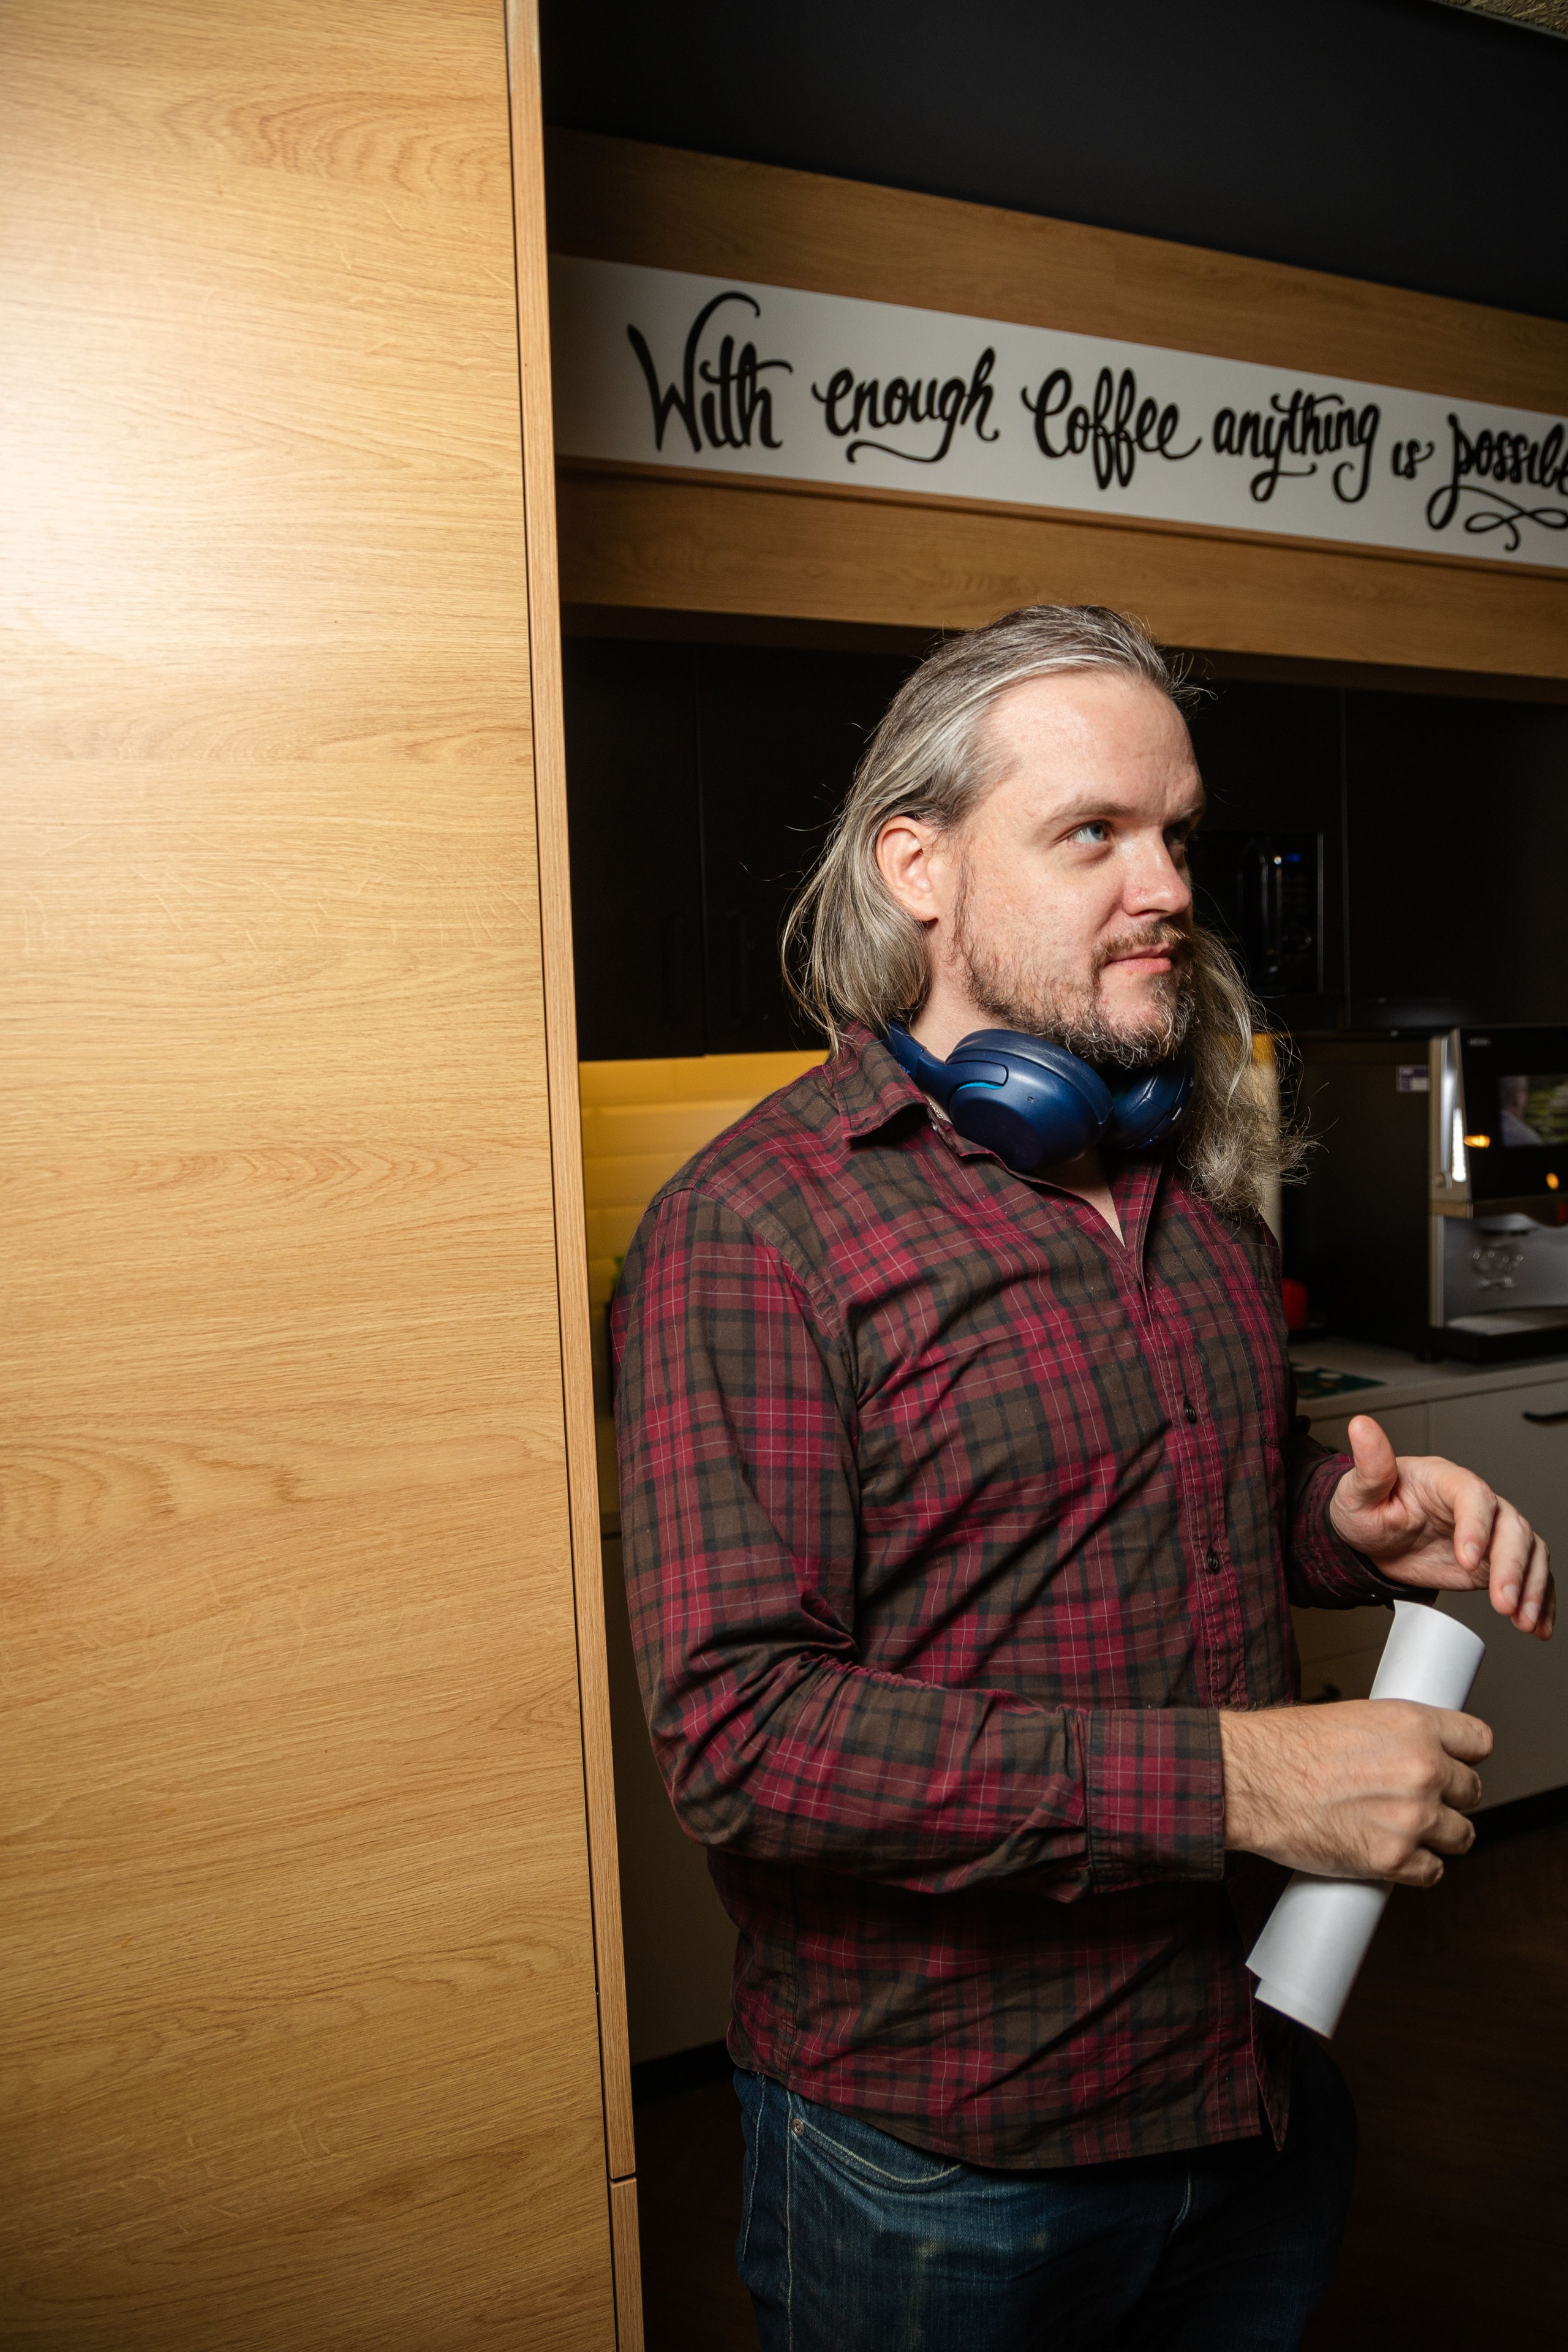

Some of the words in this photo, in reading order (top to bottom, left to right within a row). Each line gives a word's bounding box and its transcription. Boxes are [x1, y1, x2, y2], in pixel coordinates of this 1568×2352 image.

[627, 290, 793, 453] With
[811, 345, 1000, 464] enough
[1020, 367, 1202, 491] Coffee
[1213, 389, 1381, 503] anything
[1390, 439, 1436, 481] is
